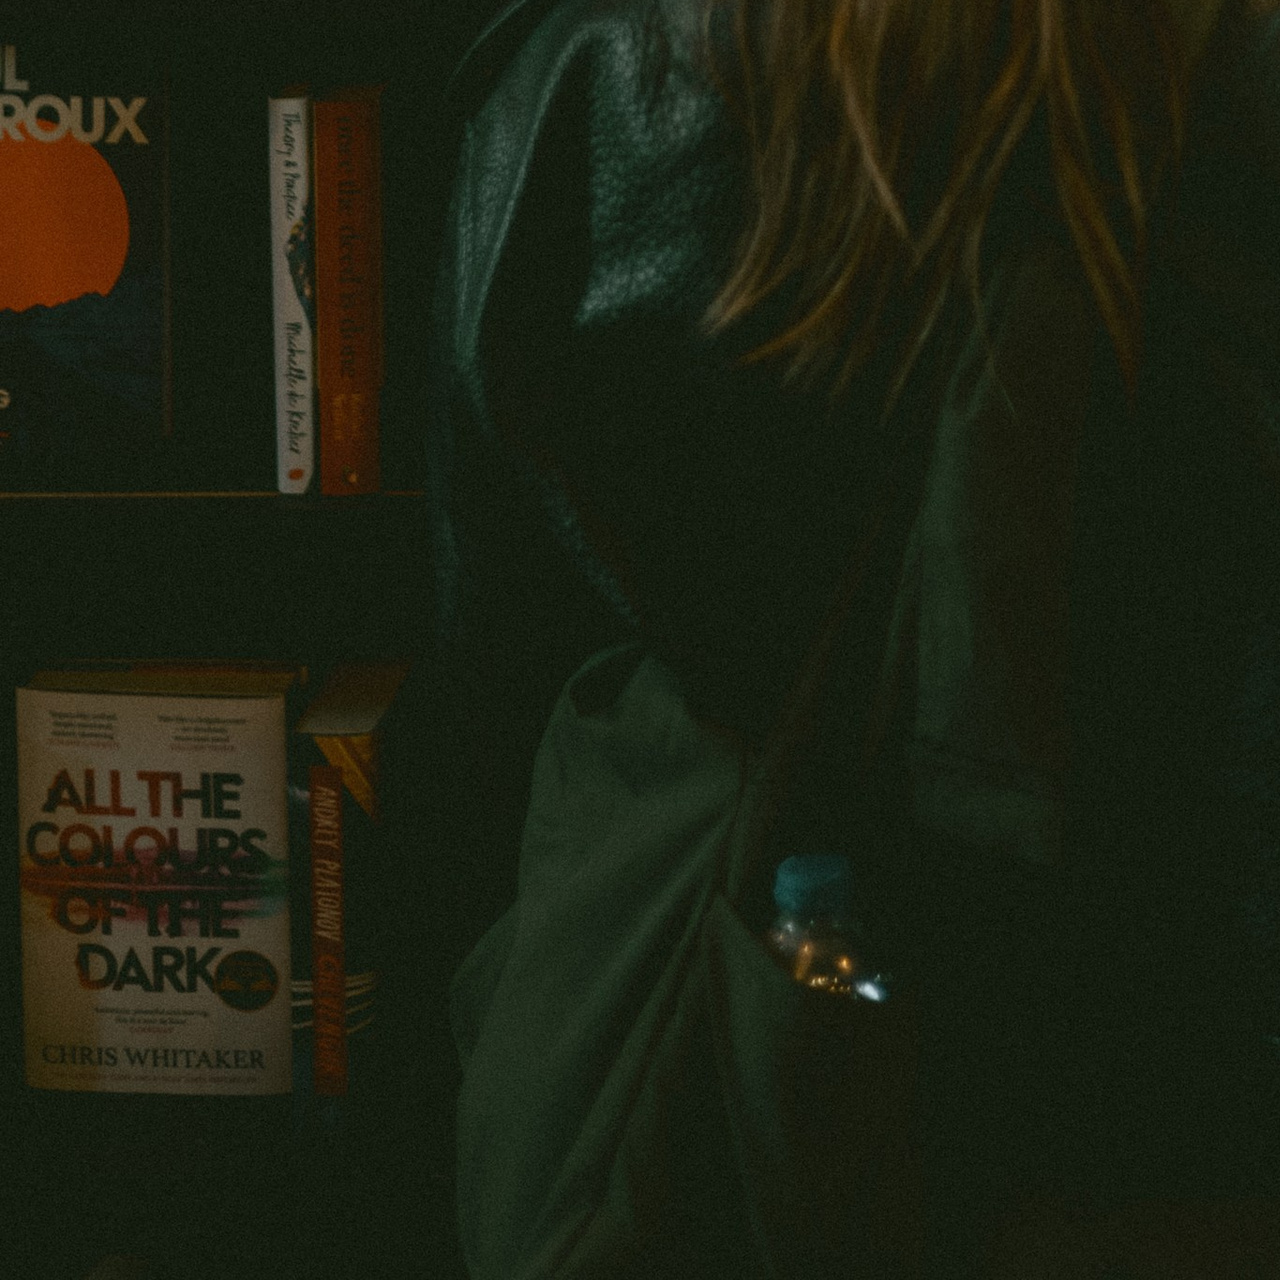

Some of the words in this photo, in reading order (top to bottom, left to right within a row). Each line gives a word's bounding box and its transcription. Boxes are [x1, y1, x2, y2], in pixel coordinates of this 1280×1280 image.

[78, 944, 221, 992] DARK
[42, 1045, 117, 1067] CHRIS
[126, 1047, 265, 1069] WHITAKER
